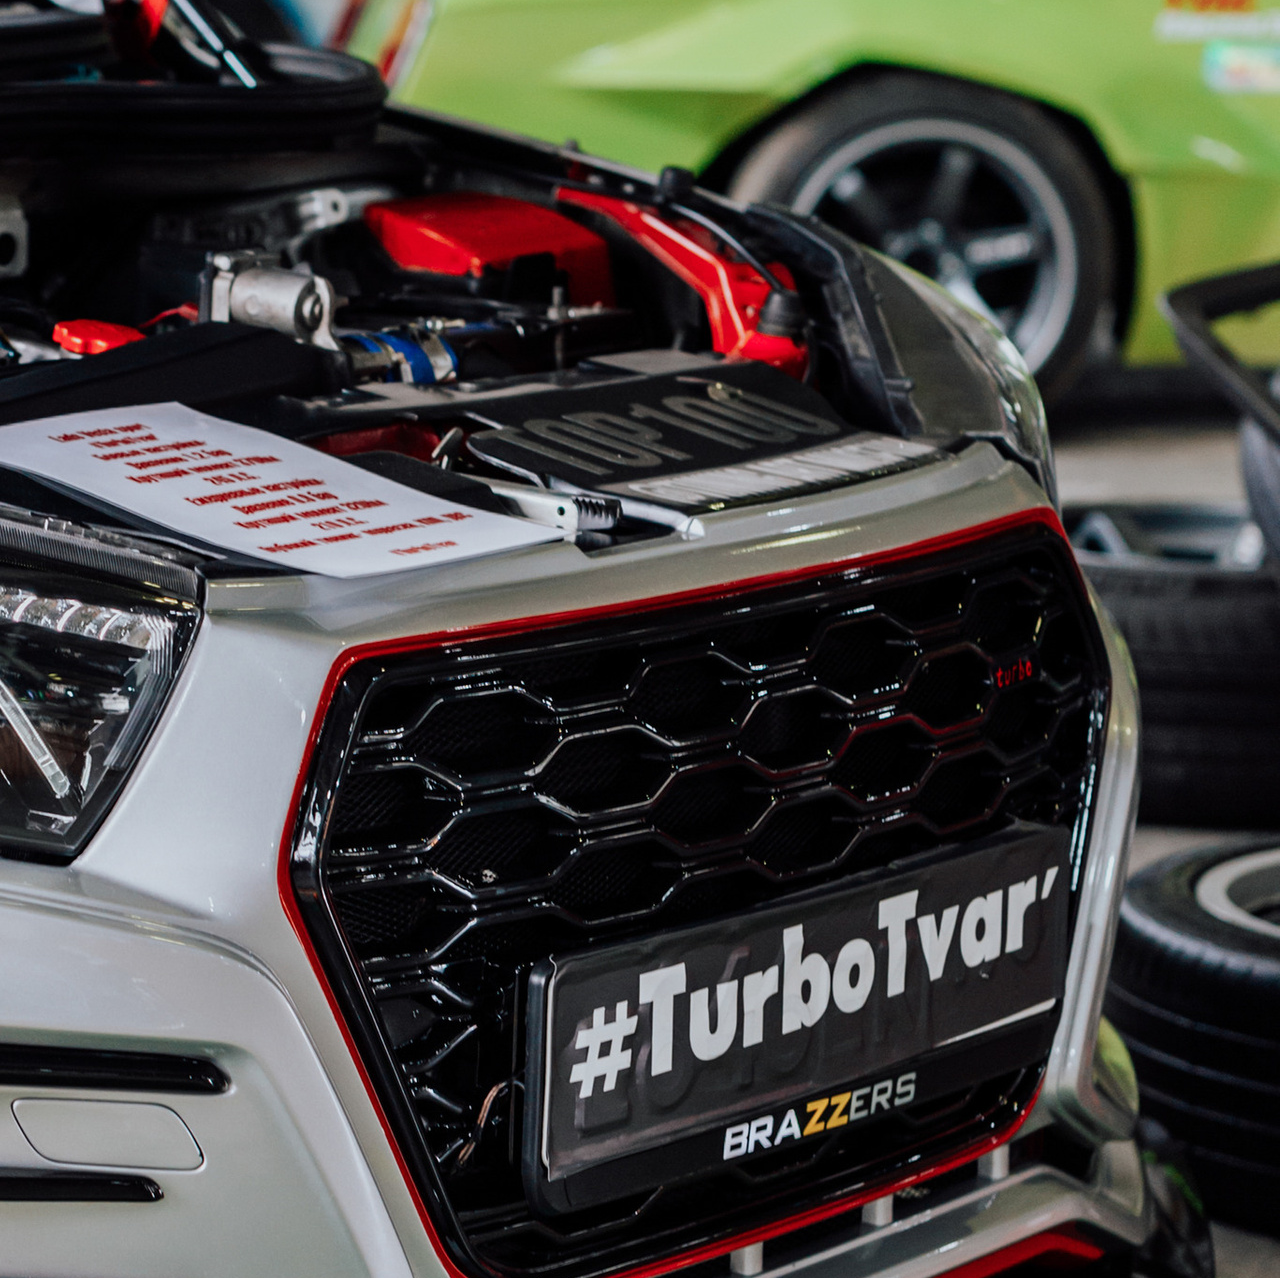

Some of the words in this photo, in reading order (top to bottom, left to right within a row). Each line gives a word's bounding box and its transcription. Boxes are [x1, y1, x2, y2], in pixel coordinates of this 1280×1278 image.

[478, 411, 693, 476] TOP
[631, 382, 841, 450] 100
[995, 657, 1033, 688] turbo
[722, 1072, 917, 1161] BRAZZERS
